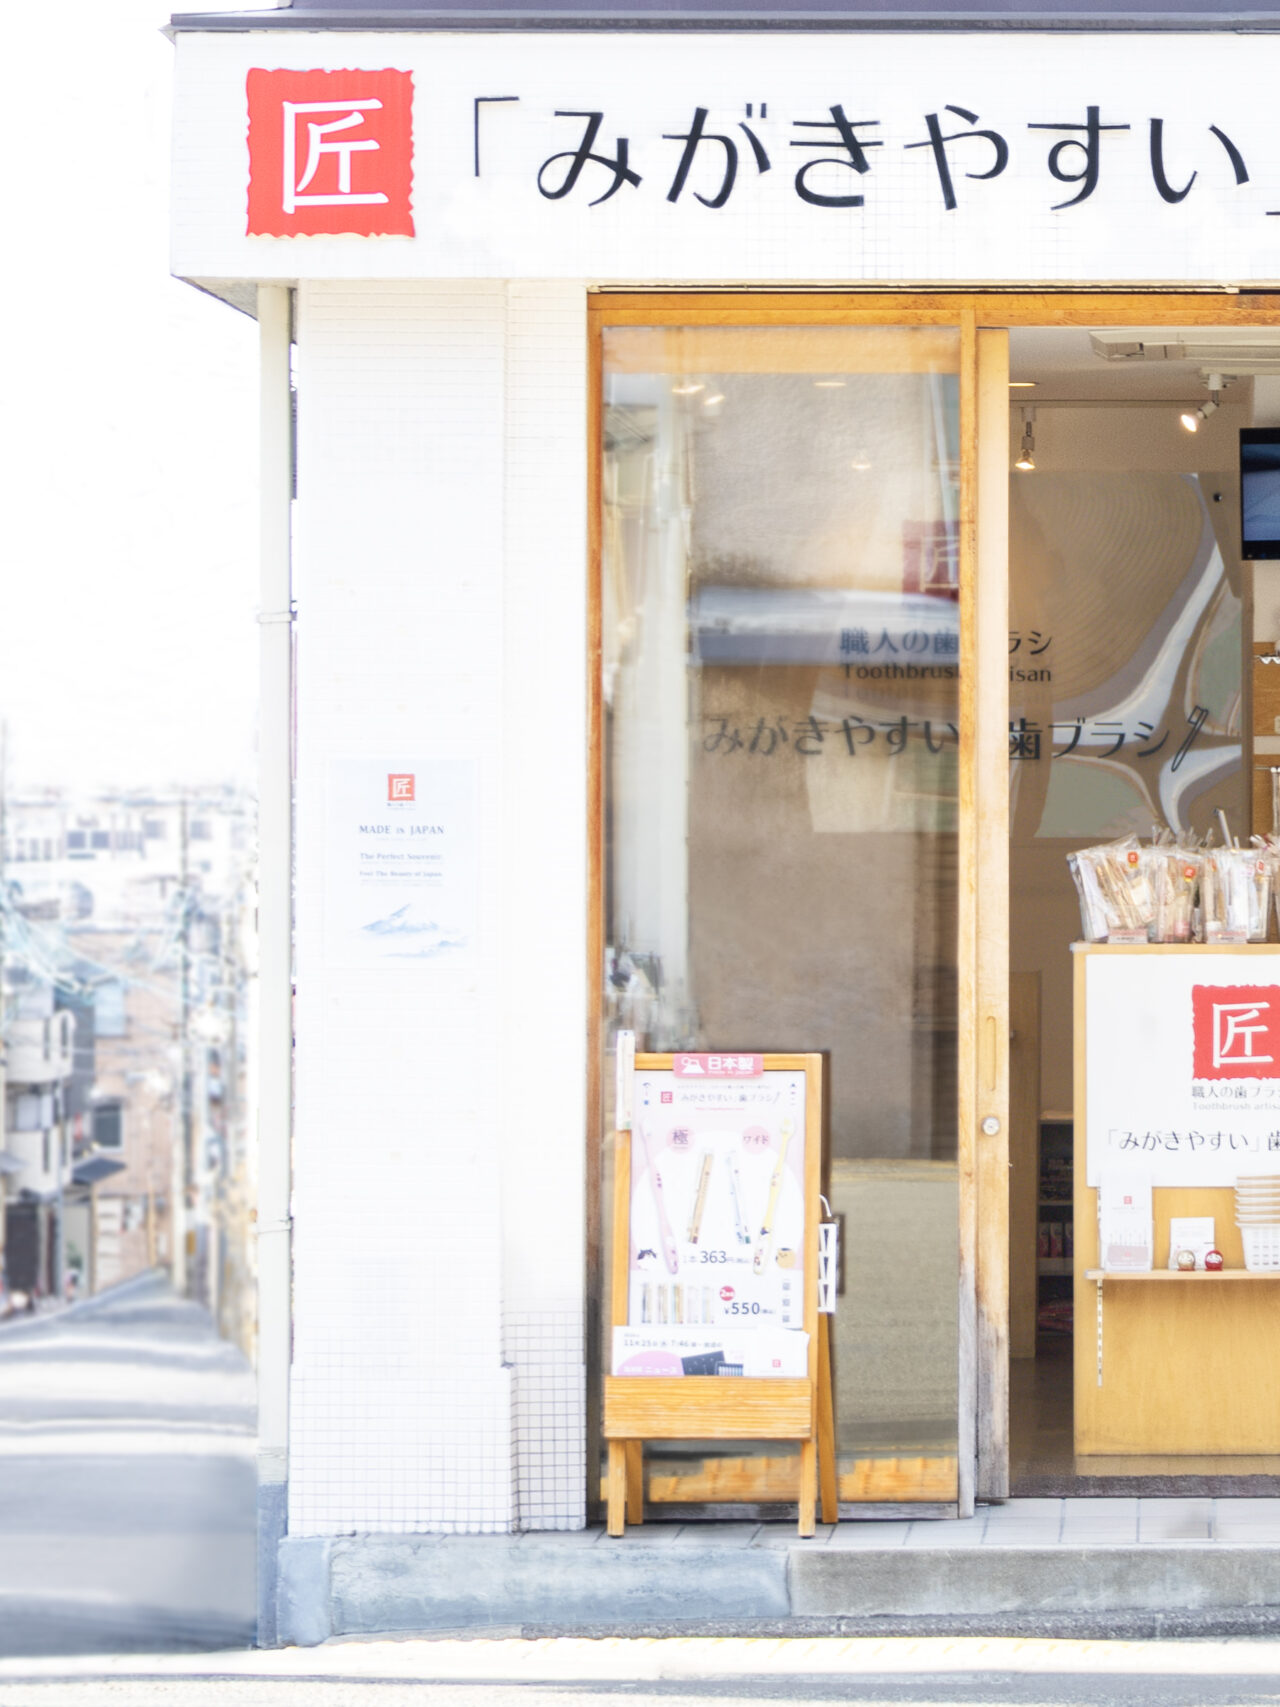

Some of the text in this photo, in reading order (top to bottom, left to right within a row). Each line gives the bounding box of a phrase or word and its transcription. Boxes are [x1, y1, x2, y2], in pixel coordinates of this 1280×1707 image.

[281, 97, 390, 214] 匠
[841, 662, 960, 680] Toothbrus
[359, 825, 391, 834] MADE
[410, 825, 444, 836] JAPAN
[1212, 1001, 1274, 1068] 匠
[707, 1056, 754, 1071] 日本製
[1192, 1102, 1251, 1111] Toothbrush
